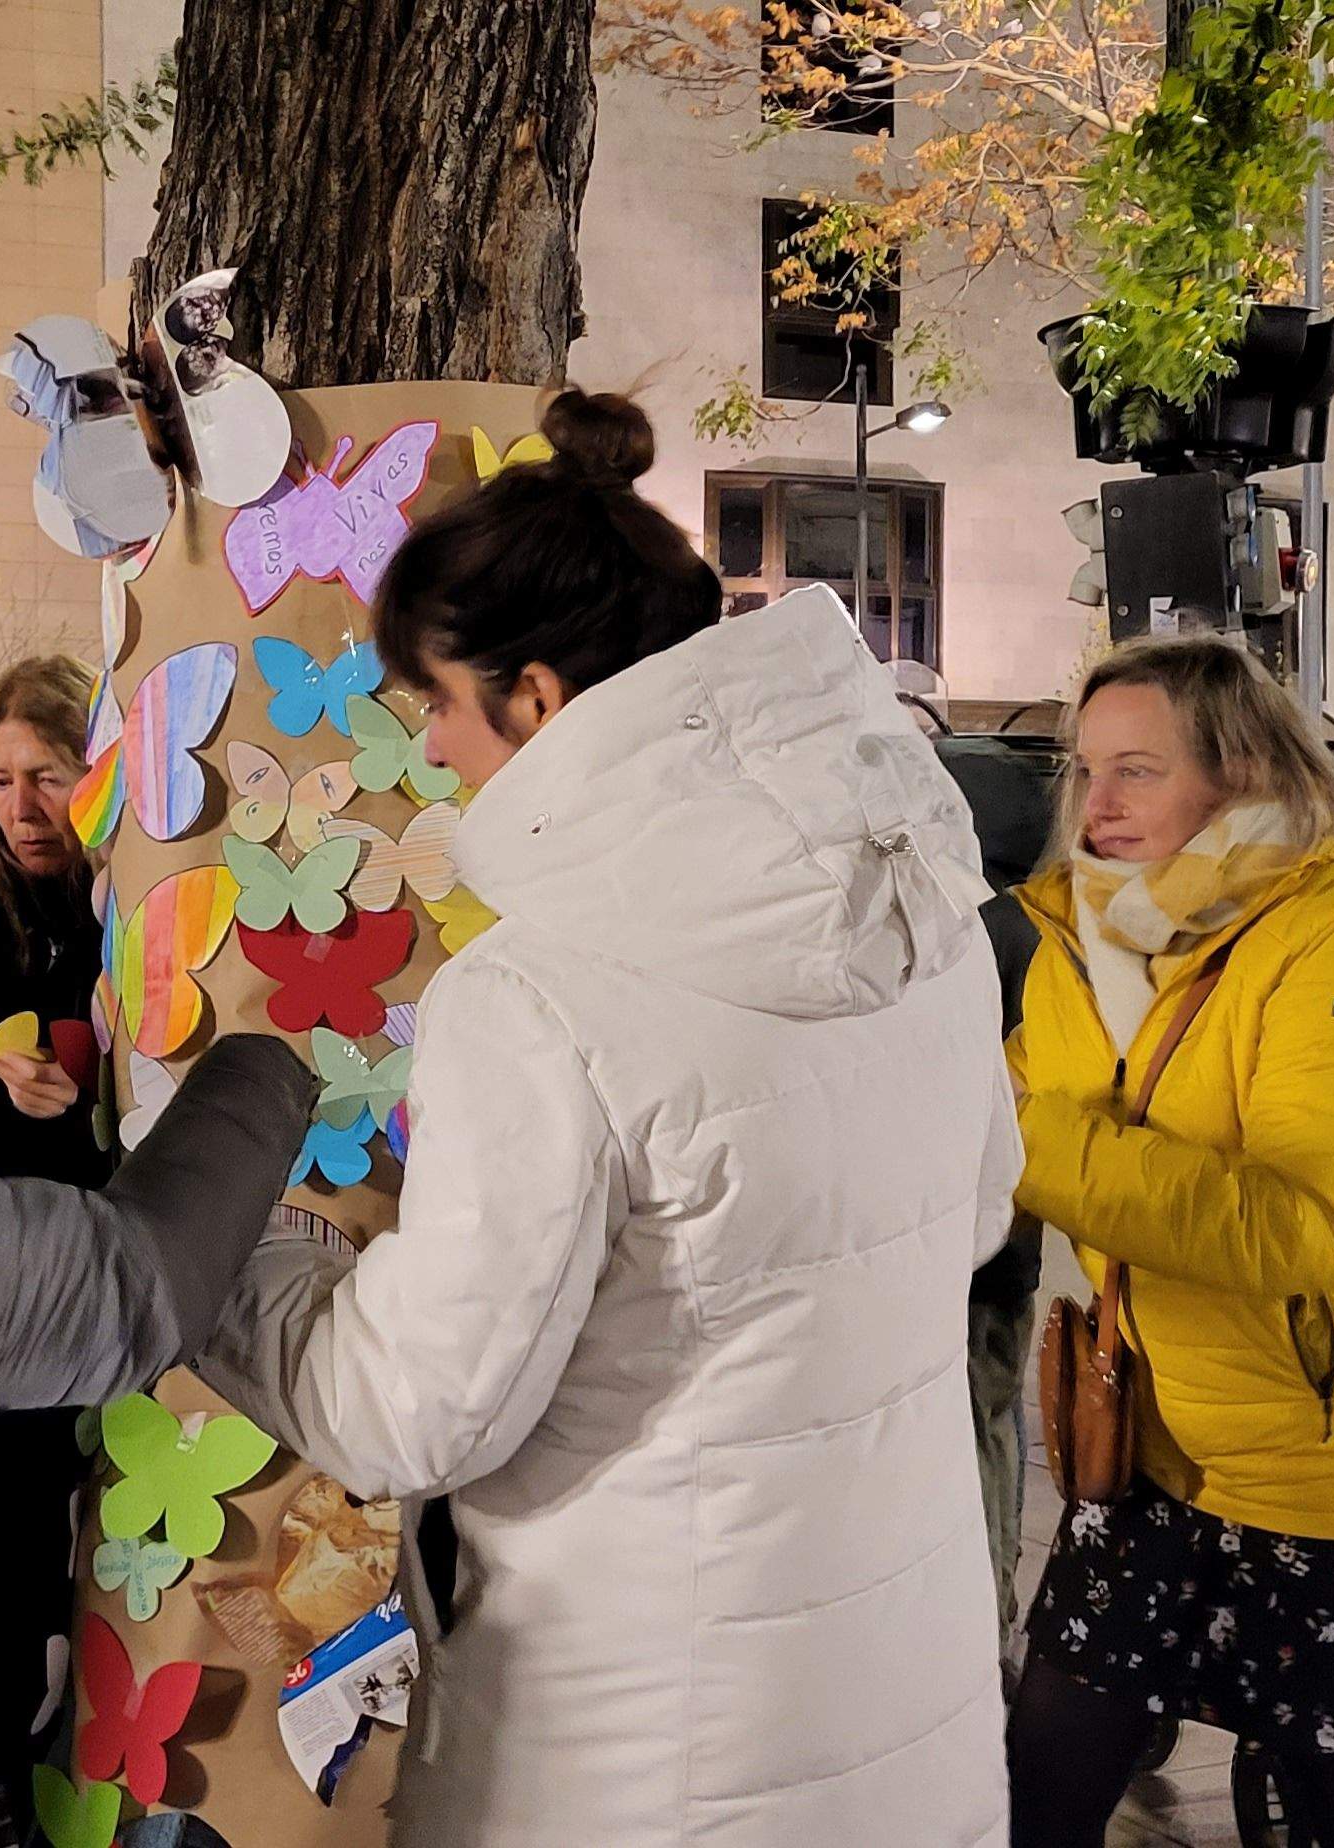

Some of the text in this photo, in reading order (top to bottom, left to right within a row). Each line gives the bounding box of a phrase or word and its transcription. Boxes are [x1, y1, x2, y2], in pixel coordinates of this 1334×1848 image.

[333, 452, 409, 535] Vivas
[258, 502, 283, 576] remos
[357, 540, 388, 574] nos
